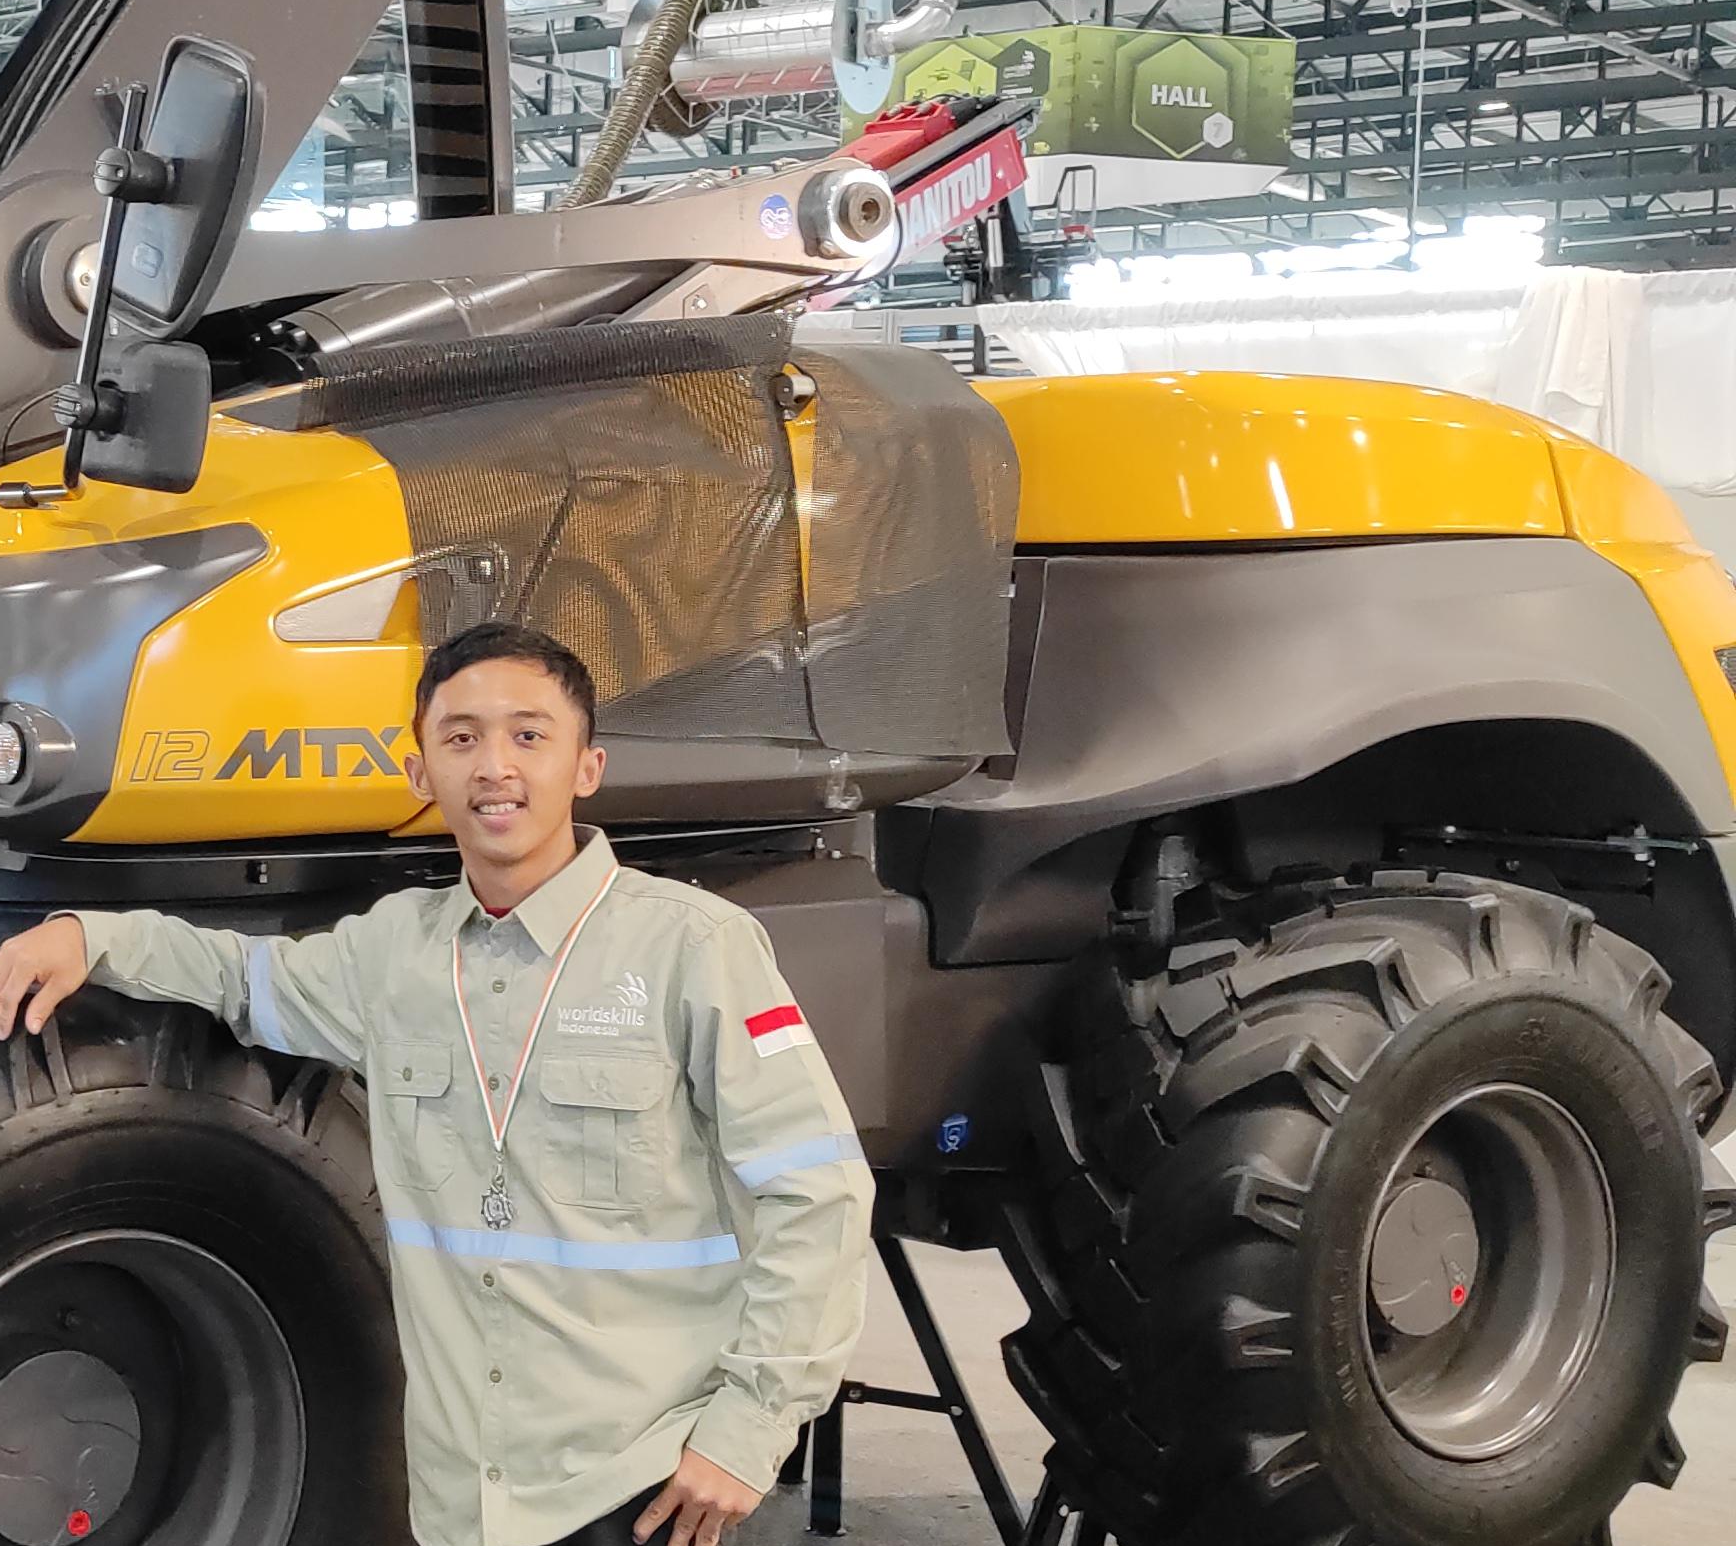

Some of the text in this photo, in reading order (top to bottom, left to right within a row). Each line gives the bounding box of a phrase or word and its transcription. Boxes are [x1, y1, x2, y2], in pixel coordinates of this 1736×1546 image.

[1151, 84, 1213, 107] HALL
[130, 725, 405, 783] 12 MTX
[557, 1006, 646, 1027] worldskills
